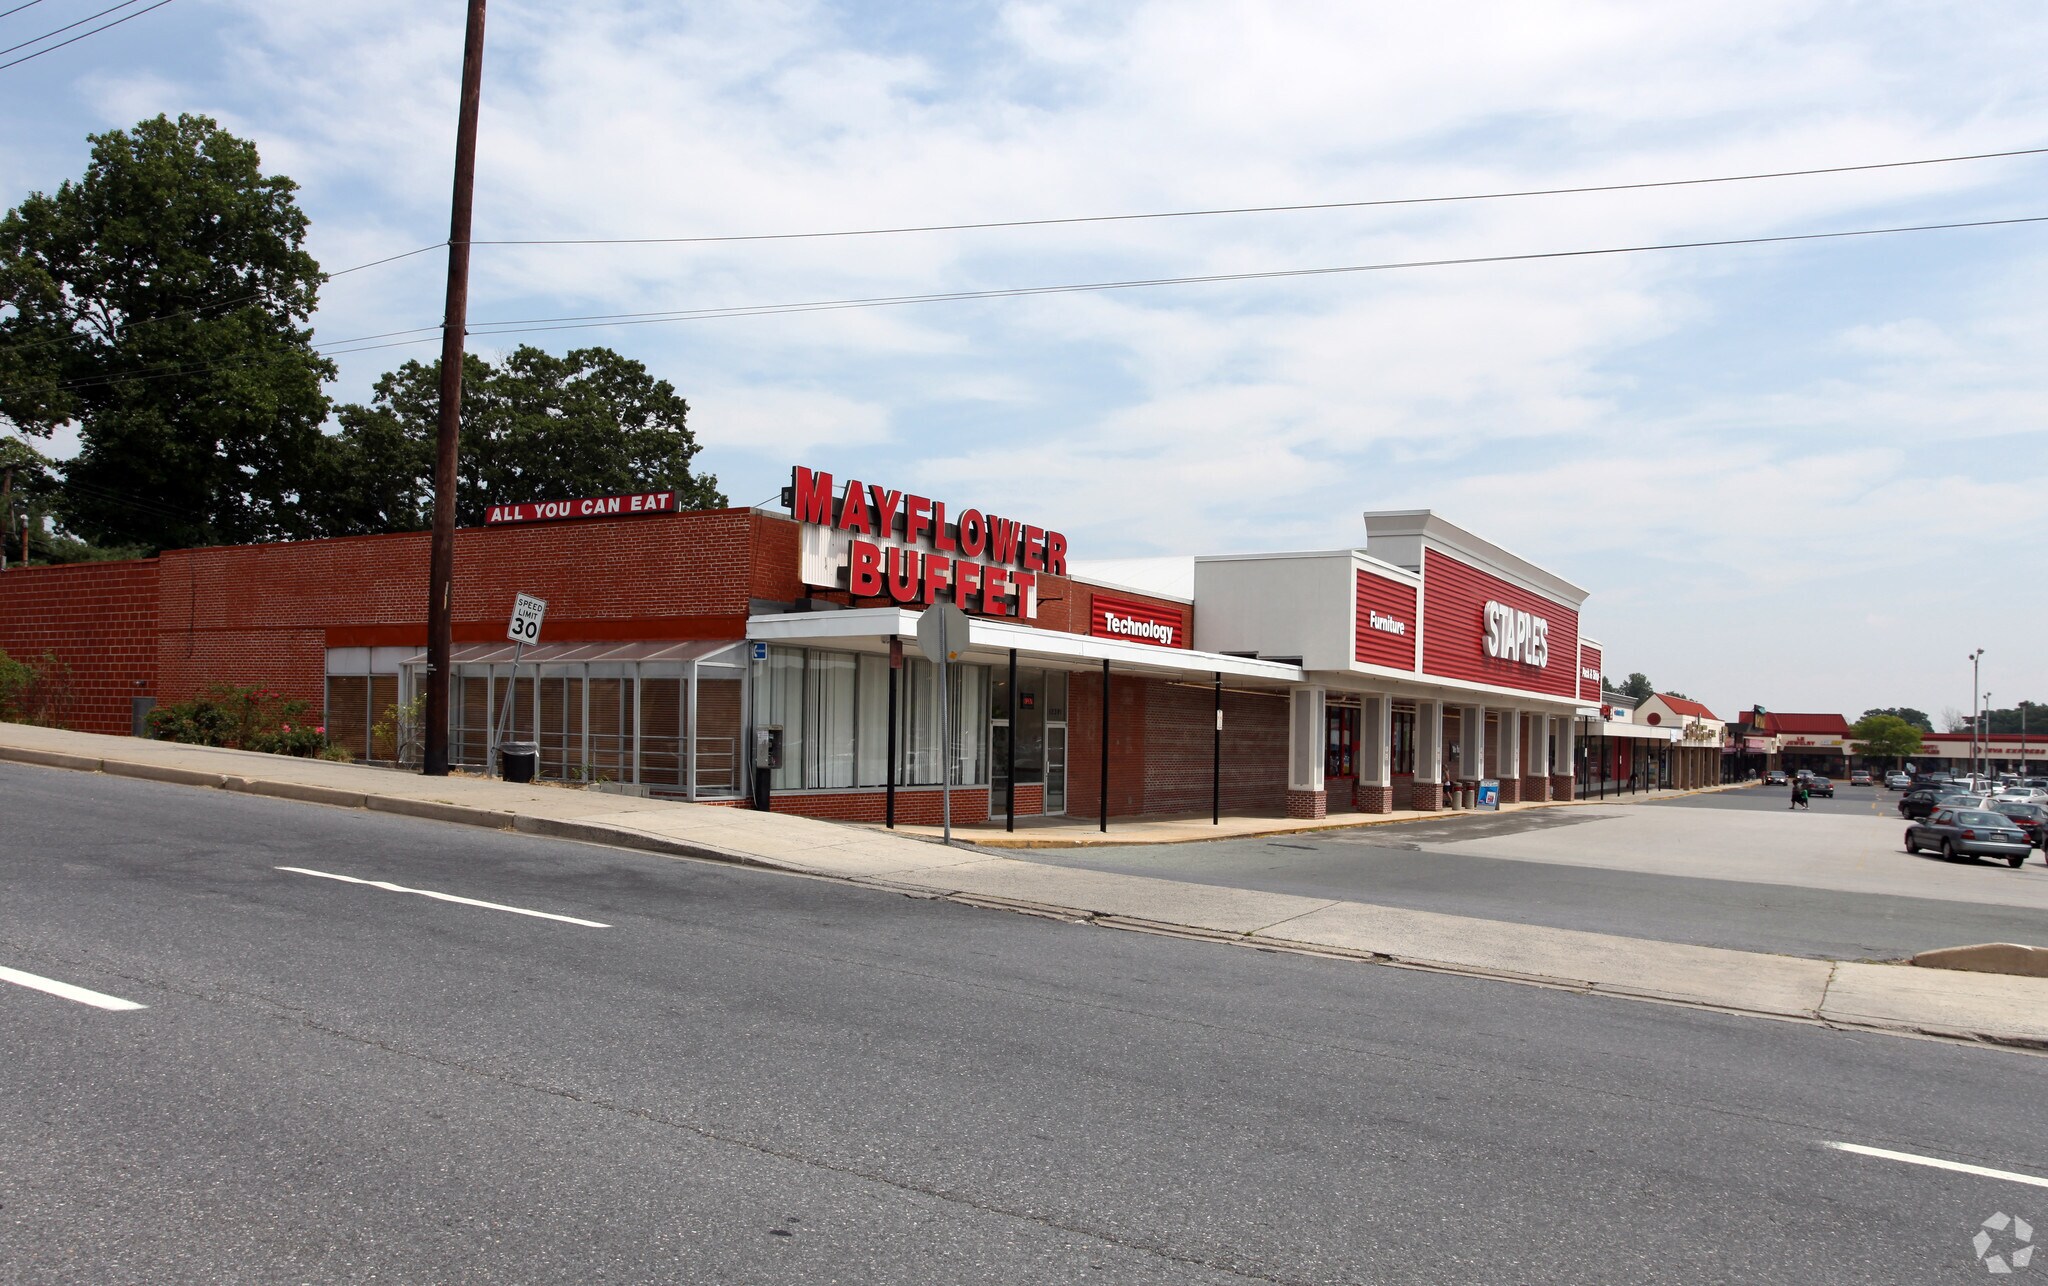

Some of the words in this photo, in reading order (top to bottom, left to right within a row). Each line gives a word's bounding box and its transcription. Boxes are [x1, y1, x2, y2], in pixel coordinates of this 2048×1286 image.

[490, 506, 523, 522] ALL
[534, 502, 571, 518] YOU
[581, 498, 620, 514] CAN
[630, 493, 670, 511] EAT
[793, 465, 1068, 576] MAYFLOWER
[850, 539, 1035, 619] BUFFET
[518, 598, 543, 612] SPEED
[518, 608, 538, 620] LIMIT
[512, 617, 537, 639] 30
[1104, 611, 1174, 645] Technology
[1370, 610, 1405, 636] Furniture
[1482, 600, 1549, 669] STAPLES
